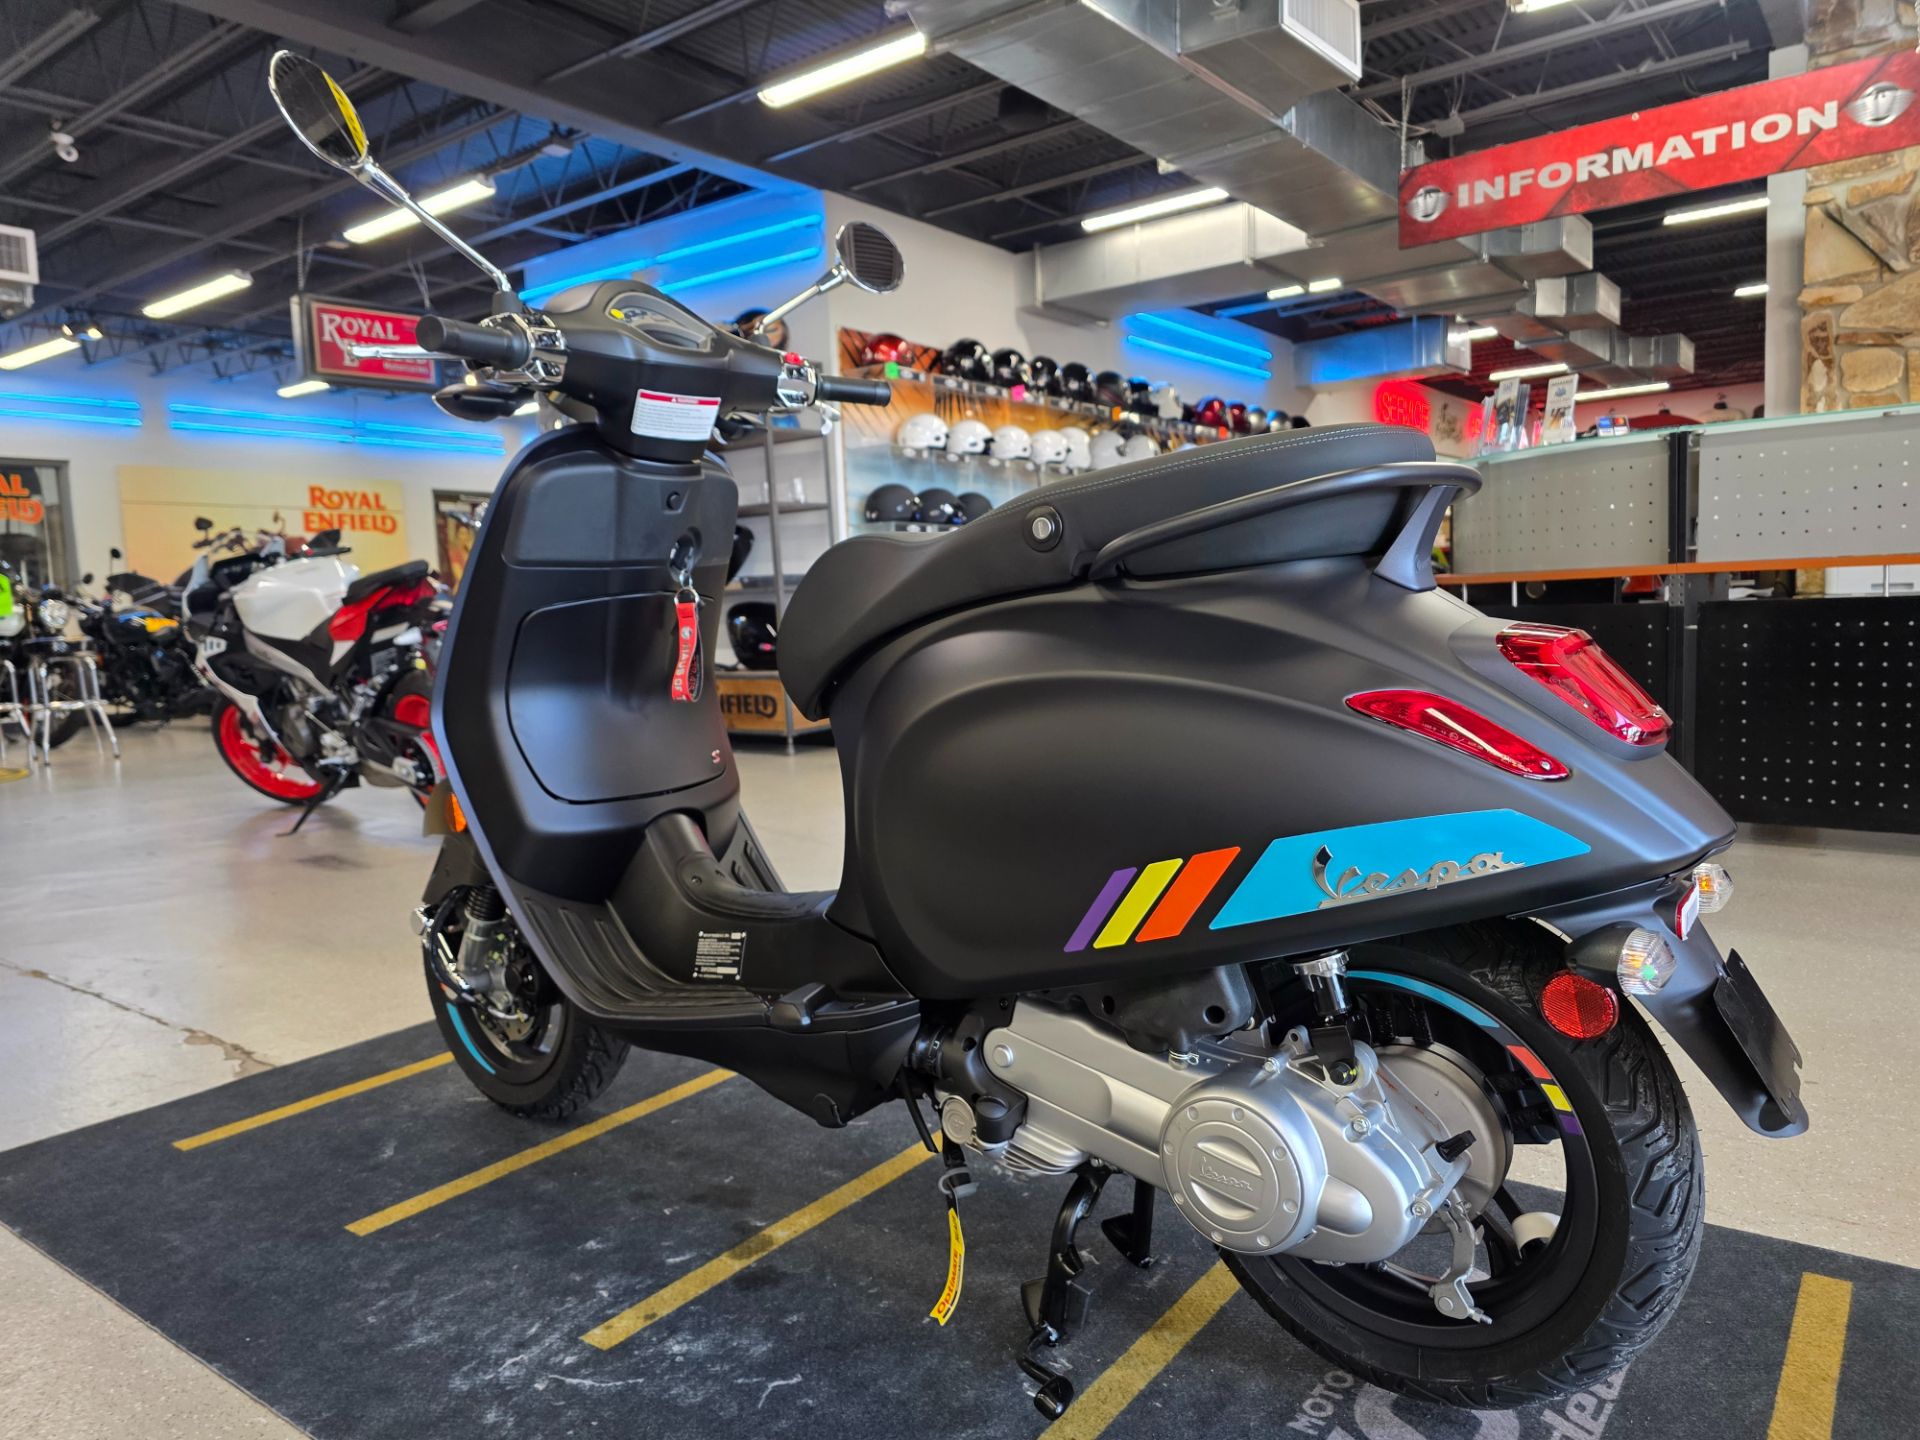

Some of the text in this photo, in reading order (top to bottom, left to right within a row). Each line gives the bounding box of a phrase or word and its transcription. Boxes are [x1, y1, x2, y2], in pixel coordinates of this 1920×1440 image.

[1457, 100, 1840, 208] INFORMATION
[320, 312, 401, 345] ROYAL
[308, 485, 386, 511] ROYAL
[303, 511, 398, 535] ENFIELD
[1312, 844, 1526, 909] Vespa
[1287, 1370, 1355, 1435] MOTO
